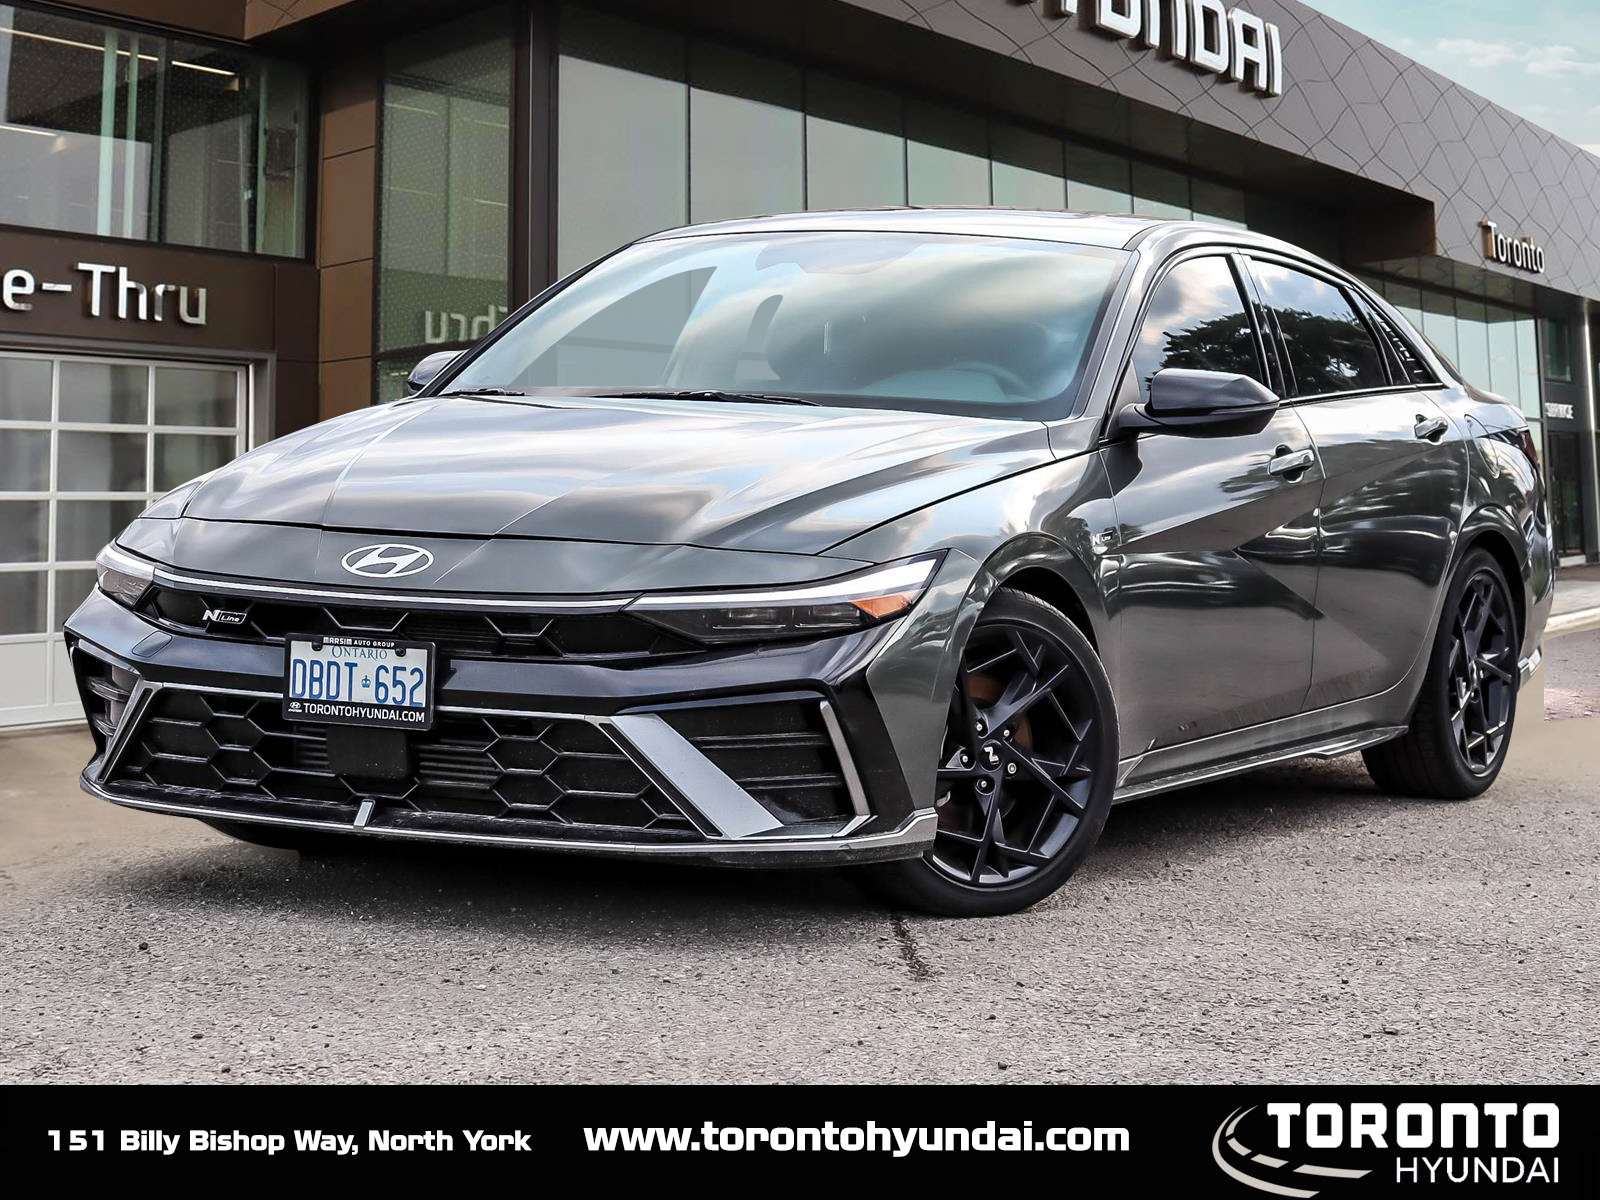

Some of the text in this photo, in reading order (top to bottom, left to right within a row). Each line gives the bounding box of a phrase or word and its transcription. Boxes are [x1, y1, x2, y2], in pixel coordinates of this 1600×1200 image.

[1487, 220, 1545, 273] Toronto
[203, 609, 220, 621] N
[332, 645, 388, 661] ONTARIO
[373, 641, 395, 649] GROUP
[292, 658, 424, 707] DBDT 652
[303, 702, 425, 722] TORONTOHYUNDAI.COM
